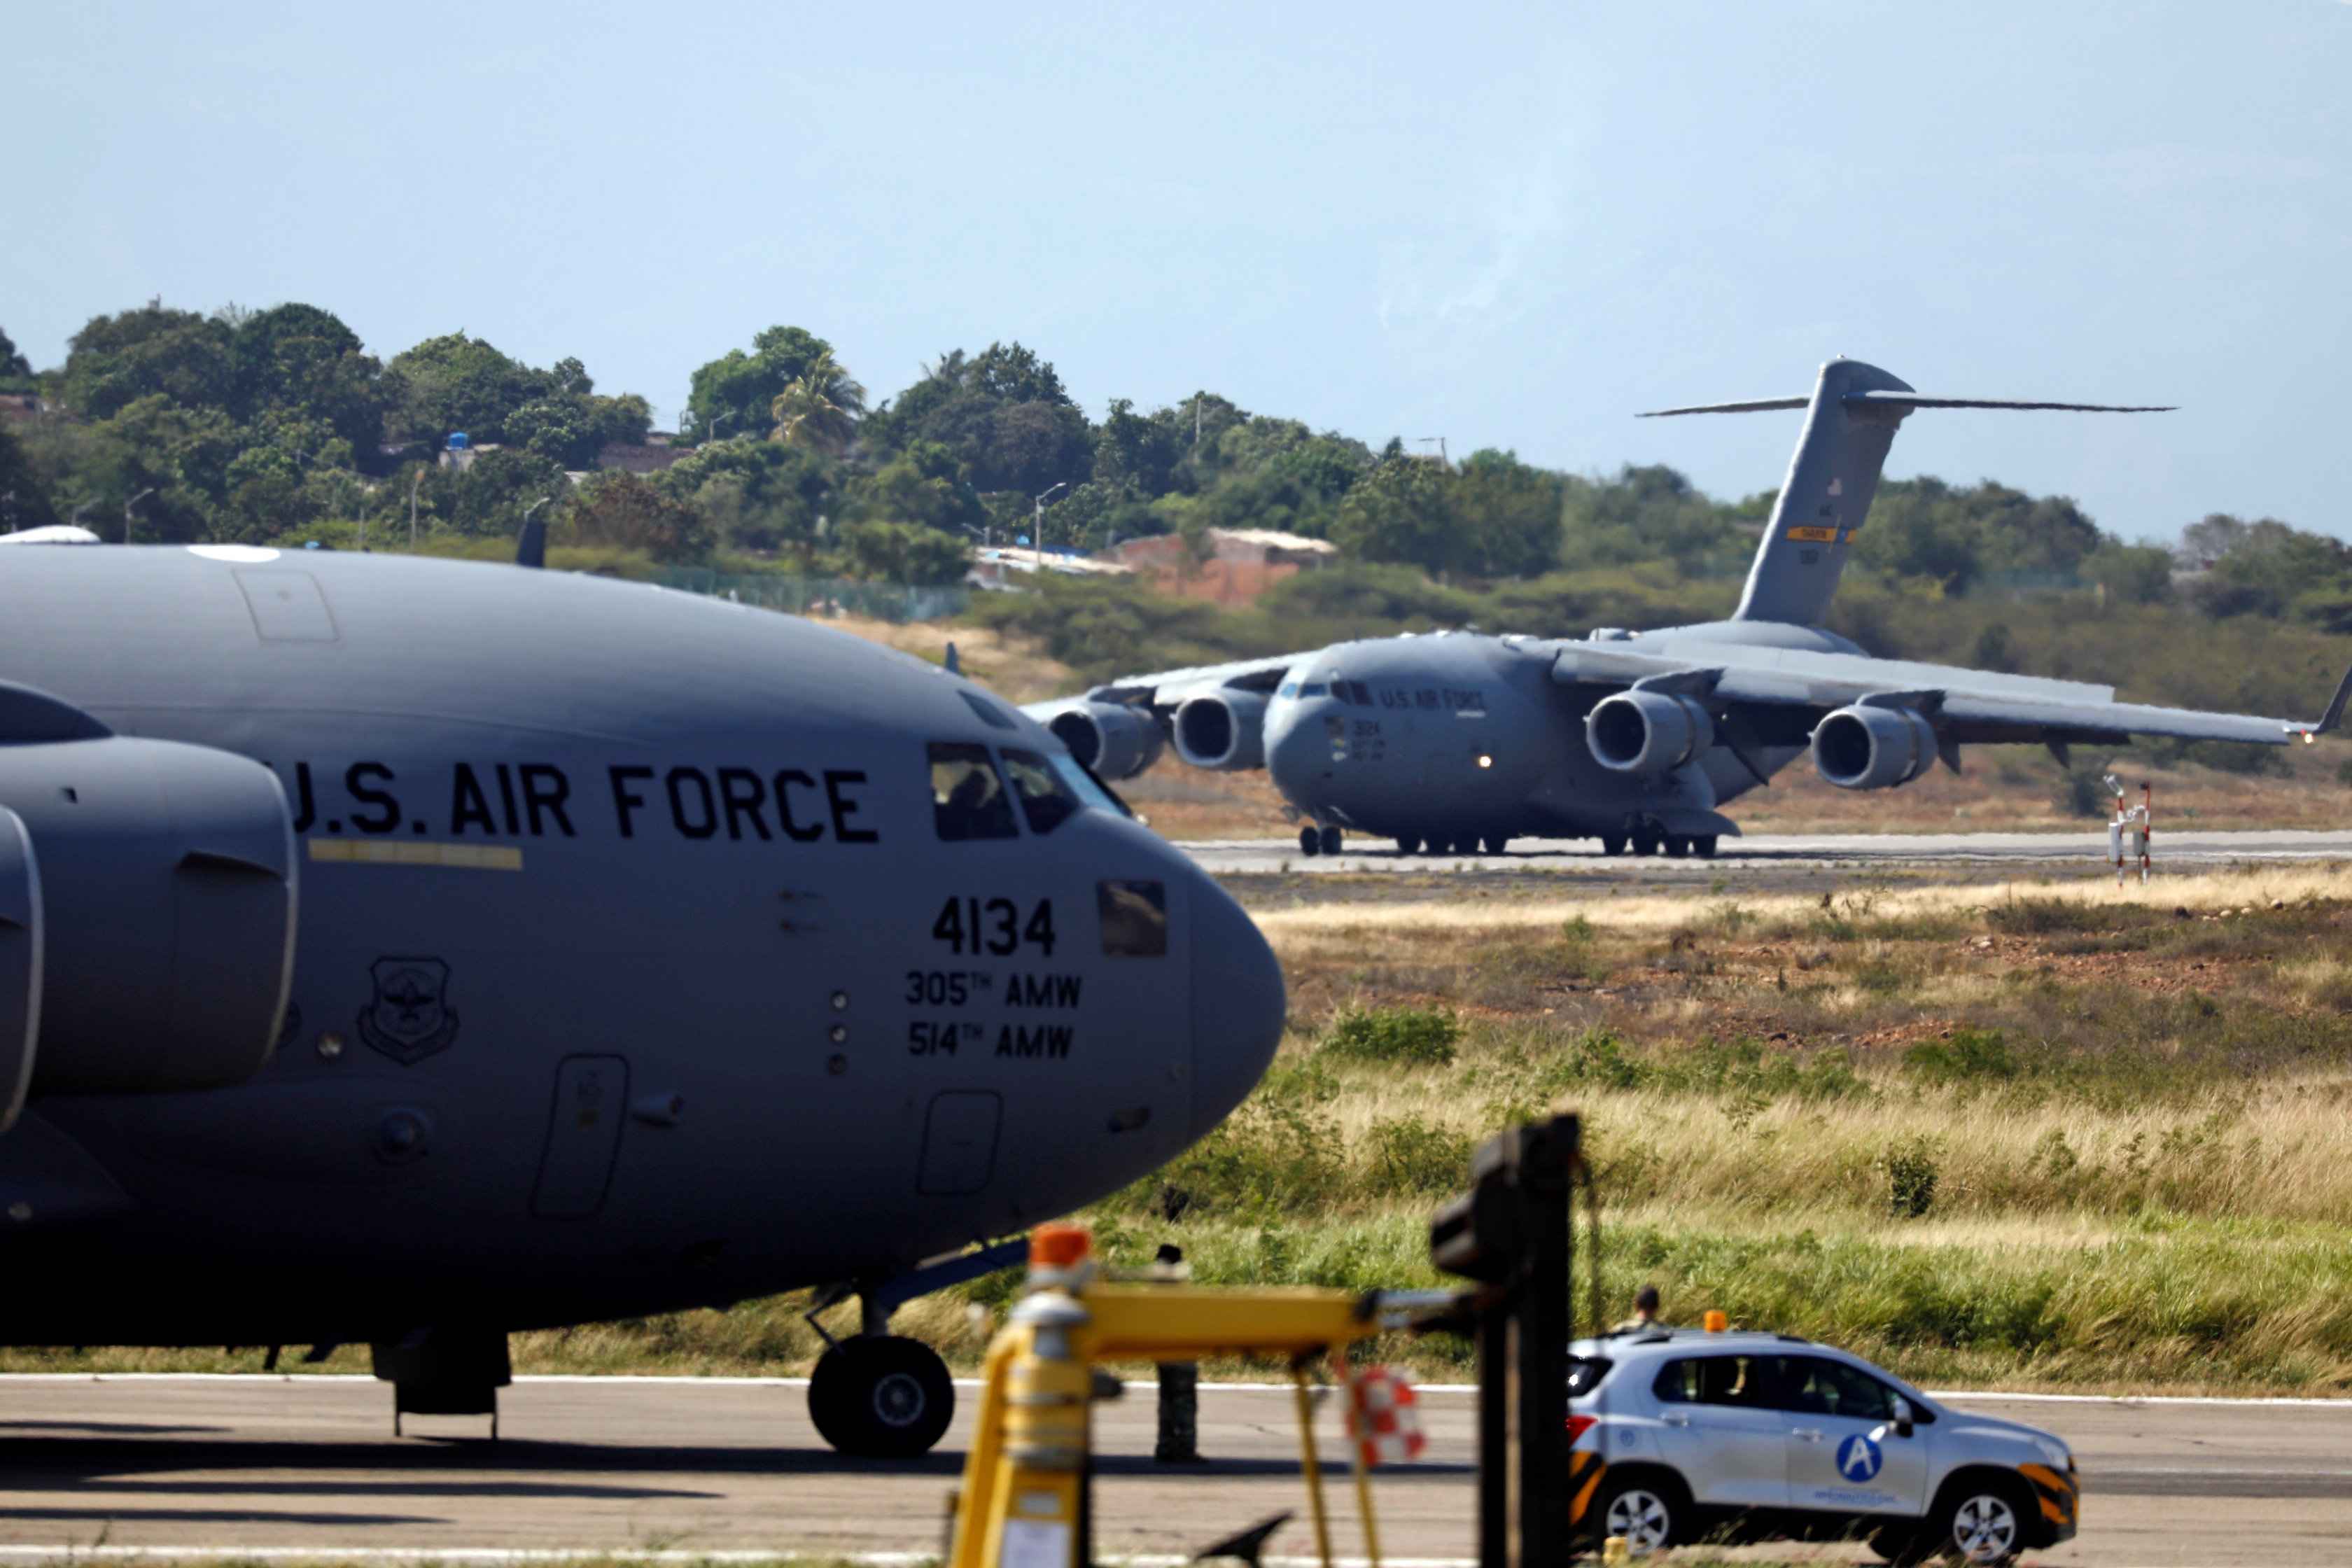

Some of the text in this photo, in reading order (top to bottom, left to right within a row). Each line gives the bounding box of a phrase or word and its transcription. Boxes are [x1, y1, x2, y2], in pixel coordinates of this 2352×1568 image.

[451, 762, 577, 836] AIR
[608, 766, 880, 842] FORCE
[932, 896, 1056, 956] 4134
[1005, 974, 1082, 1008] AMW
[995, 1025, 1074, 1059] AMW
